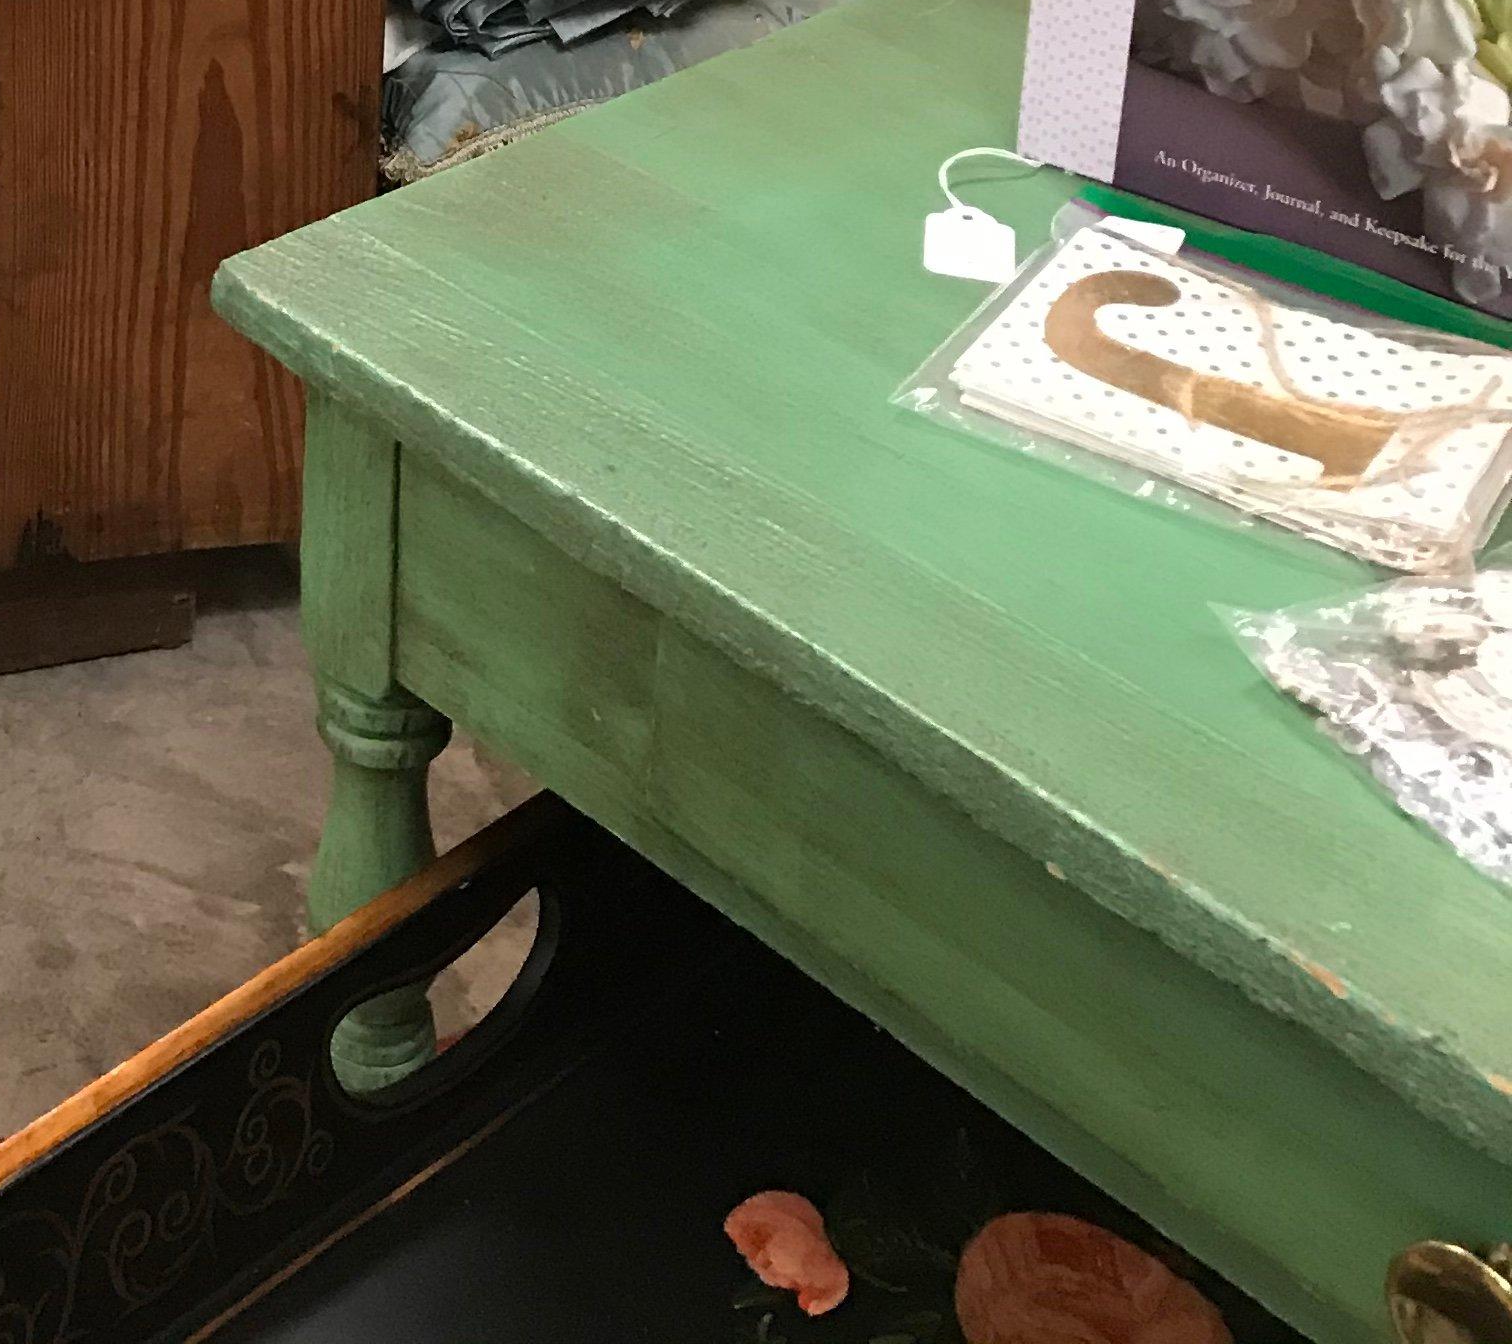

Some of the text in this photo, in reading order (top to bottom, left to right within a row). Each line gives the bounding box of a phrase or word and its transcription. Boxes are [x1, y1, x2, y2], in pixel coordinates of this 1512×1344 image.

[1154, 150, 1177, 168] An
[1181, 158, 1259, 196] Organizer,
[1264, 184, 1325, 218] Journal,
[1329, 210, 1360, 229] and
[1364, 217, 1439, 256] Keepsake
[1443, 243, 1467, 264] for
